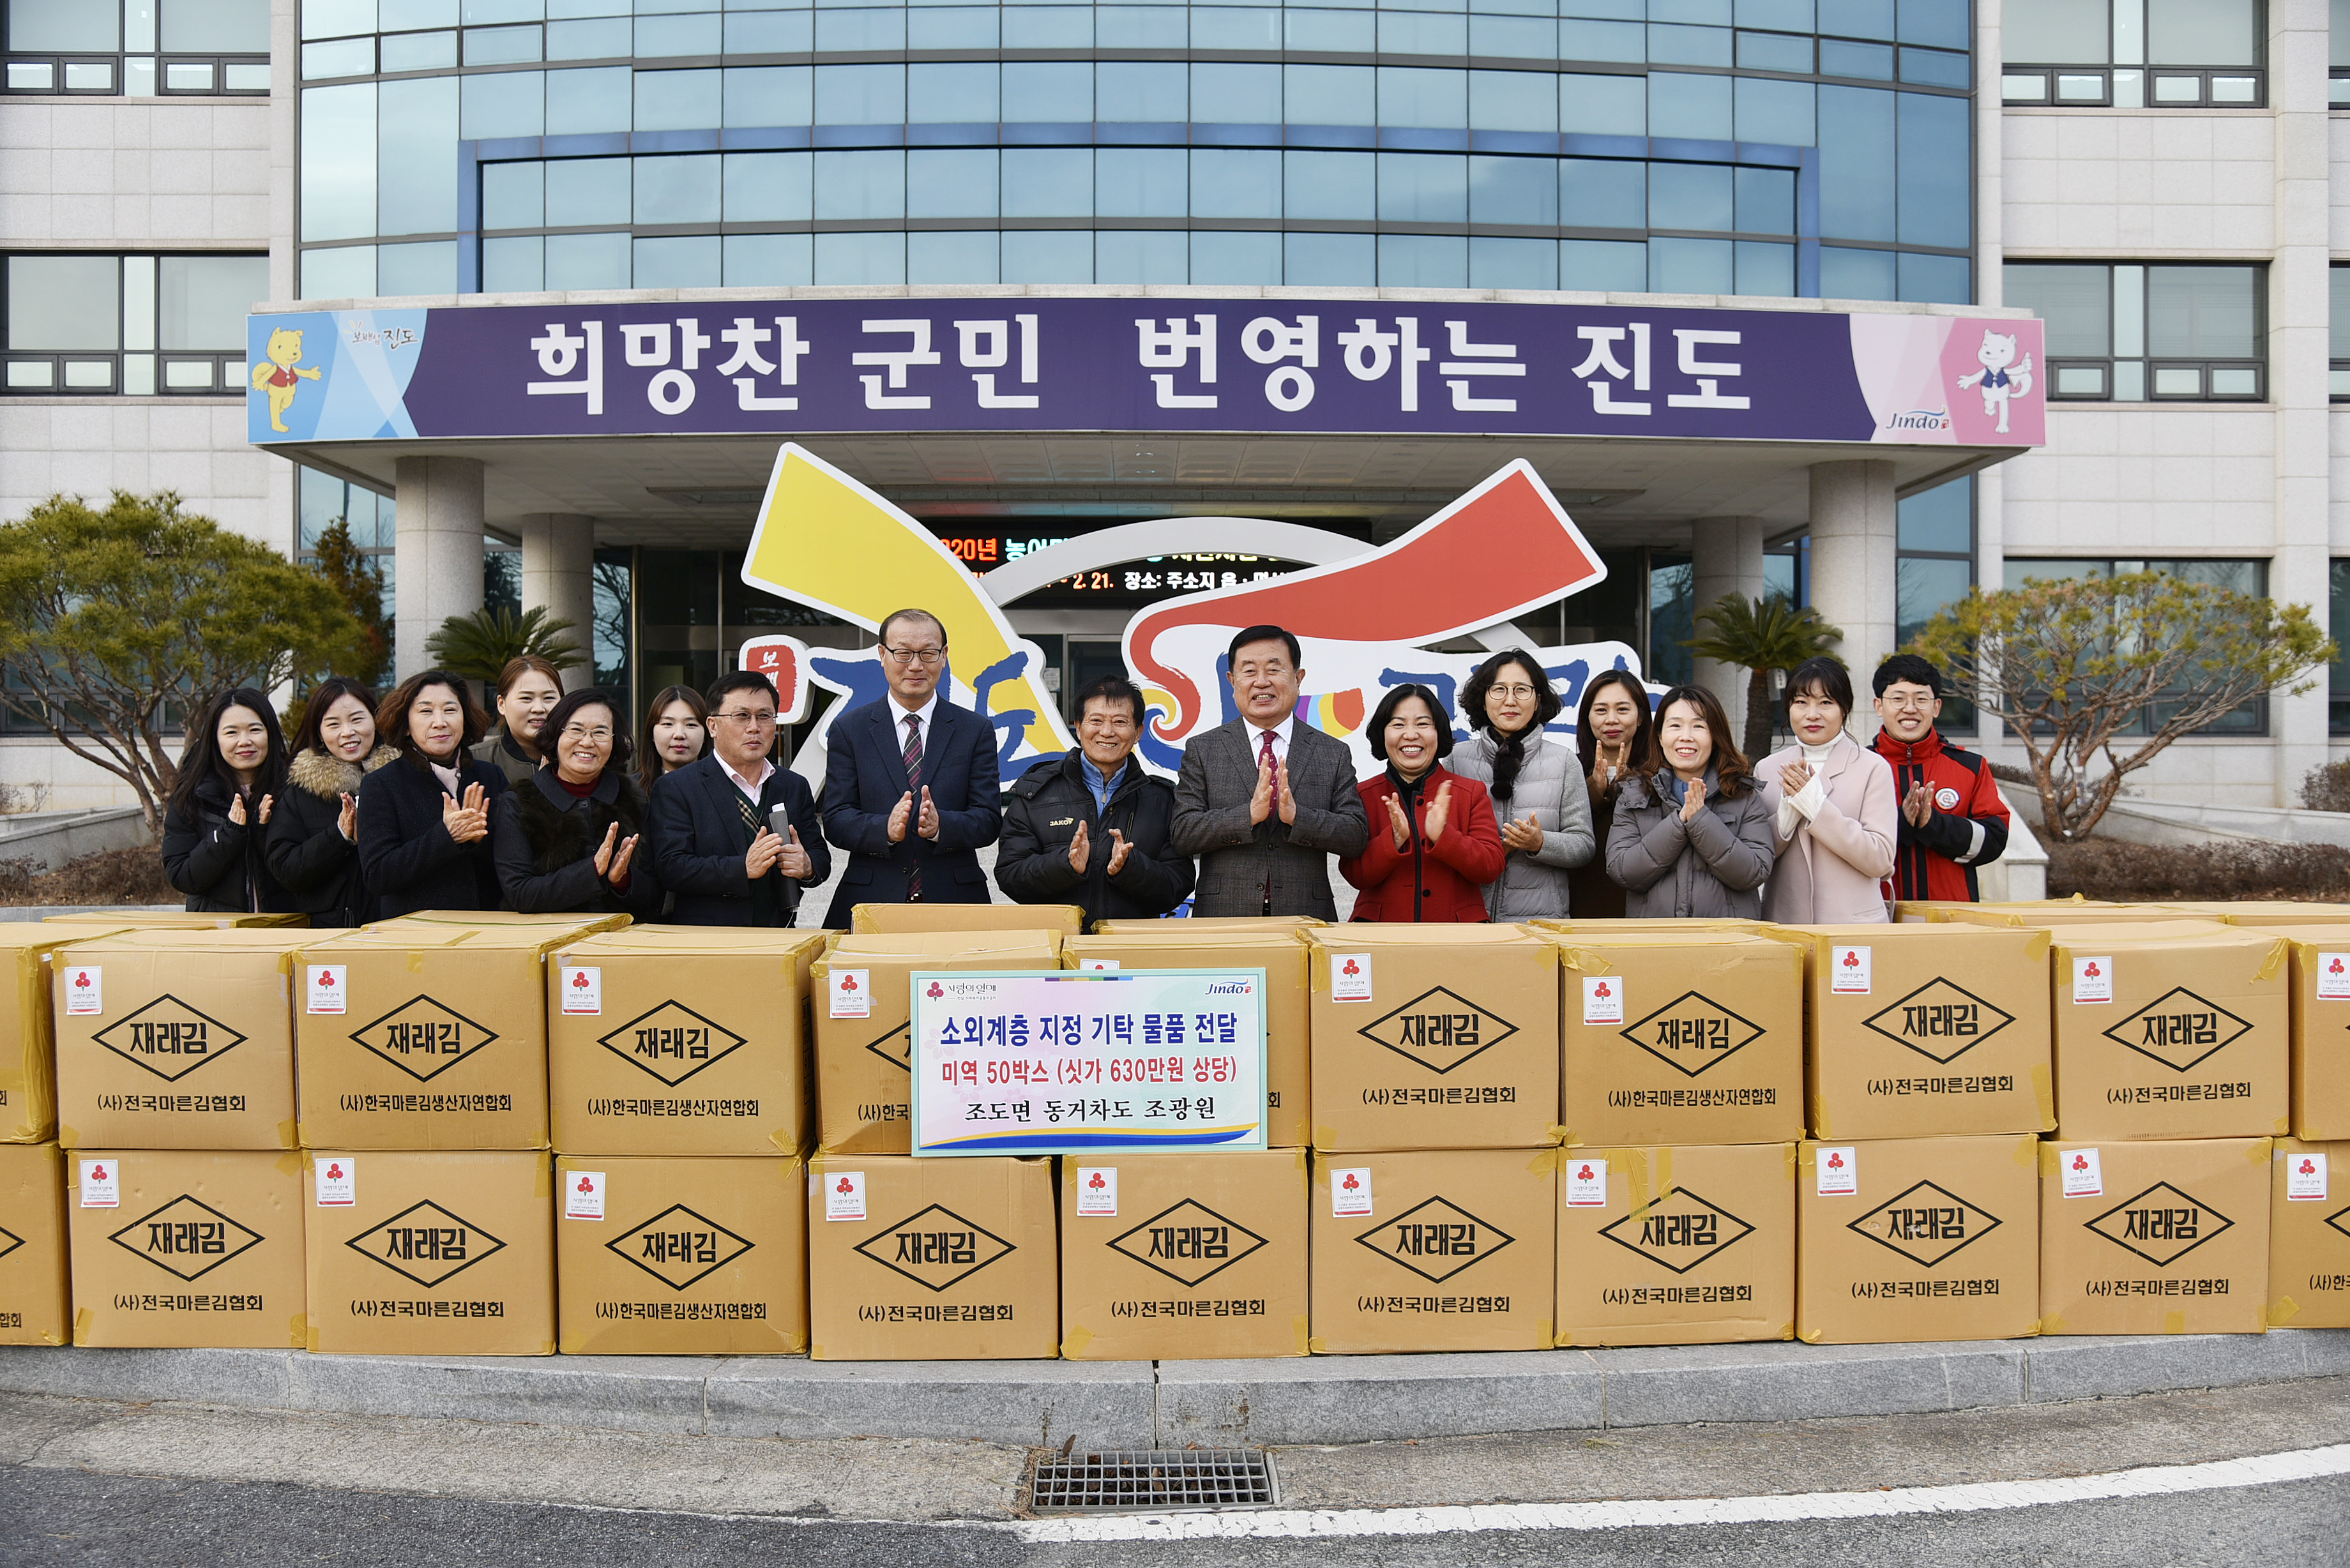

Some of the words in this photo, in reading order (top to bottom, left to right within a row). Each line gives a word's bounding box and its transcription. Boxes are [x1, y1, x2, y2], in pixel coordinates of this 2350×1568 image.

[383, 328, 419, 349] 진도
[527, 317, 809, 414] 희망찬
[853, 315, 1038, 409] 군민
[1135, 313, 1527, 412] 번영하는
[1571, 322, 1751, 416] 진도
[1885, 412, 1939, 430] Jindo
[1091, 573, 1114, 589] 21.
[1125, 572, 1162, 589] 장소:
[1167, 572, 1215, 589] 주소지
[1205, 983, 1243, 995] Jindo
[941, 1014, 1029, 1046] 소외계층
[1040, 1015, 1080, 1045] 지정
[1092, 1014, 1133, 1044] 기탁
[1143, 1014, 1185, 1043] 물품
[1196, 1013, 1237, 1043] 전달
[1400, 1013, 1480, 1048] 재래김
[1902, 1004, 1978, 1037] 재래김
[2142, 1012, 2217, 1046] 재래김
[130, 1022, 208, 1055] 재래김
[386, 1022, 460, 1055] 재래김
[634, 1027, 709, 1060] 재래김
[1656, 1018, 1730, 1050] 재래김
[944, 1060, 976, 1085] 미역
[989, 1060, 1049, 1083] 50박스
[1059, 1059, 1101, 1083] (싯가
[1112, 1057, 1183, 1082] 630만원
[1194, 1057, 1236, 1082] 상당)
[1362, 1087, 1515, 1105] (사)전국마른김협회
[1867, 1075, 2013, 1096] (사)전국마른김협회
[2107, 1082, 2250, 1104] (사)전국마른김협회
[98, 1094, 245, 1112] (사)전국마른김협회
[340, 1094, 512, 1112] (사)한국마른김생산자연합회
[588, 1098, 759, 1117] (사)한국마른김생산자연합회
[1608, 1088, 1776, 1108] (사)한국마른김생산자연합회
[858, 1104, 911, 1121] (사)한국
[966, 1101, 1031, 1122] 조도면
[1043, 1099, 1133, 1122] 동거차도
[1144, 1097, 1215, 1120] 조광원
[1640, 1214, 1717, 1247] 재래김
[1888, 1207, 1964, 1240] 재래김
[2123, 1209, 2198, 1240] 재래김
[148, 1222, 225, 1255] 재래김
[386, 1227, 466, 1261] 재래김
[642, 1231, 716, 1264] 재래김
[895, 1231, 976, 1264] 재래김
[1149, 1226, 1228, 1260] 재래김
[1396, 1223, 1474, 1256] 재래김
[1602, 1285, 1752, 1305] (사)전국마른김협회
[1851, 1279, 1999, 1299] (사)전국마른김협회
[2086, 1279, 2229, 1297] (사)전국마른김협회
[114, 1294, 262, 1311] (사)전국마른김협회
[351, 1300, 504, 1318] (사)전국마른김협회
[595, 1302, 766, 1320] (사)한국마른김생산자연합회
[858, 1304, 1013, 1322] (사)전국마른김협회
[1111, 1299, 1265, 1318] (사)전국마른김협회
[1358, 1296, 1510, 1313] (사)전국마른김협회
